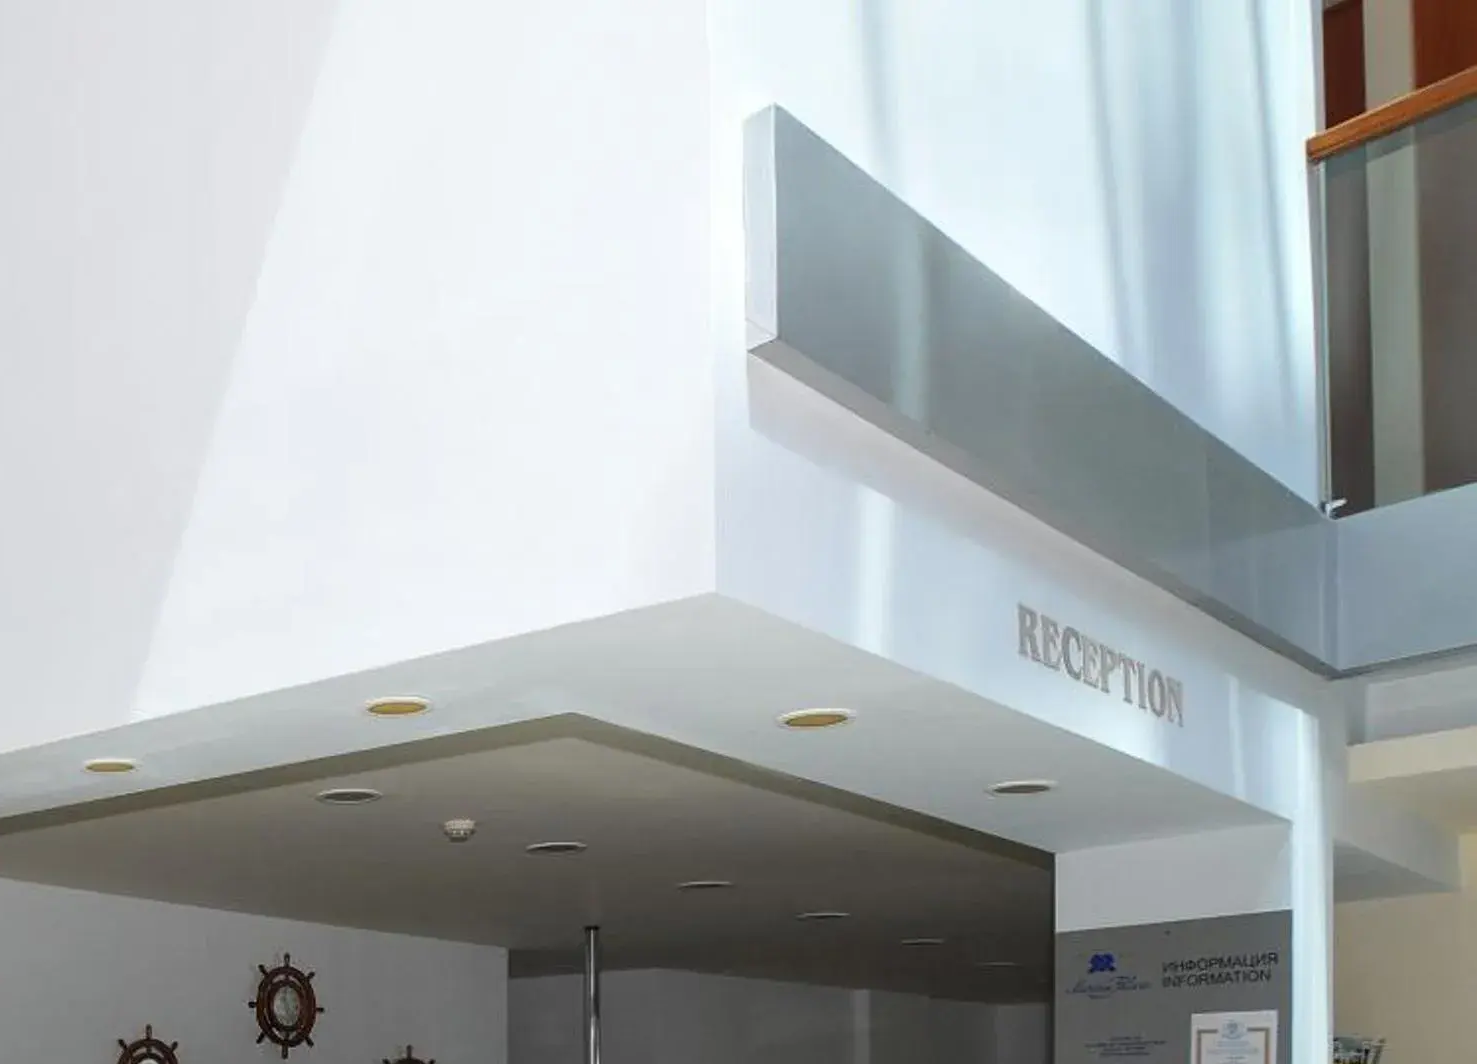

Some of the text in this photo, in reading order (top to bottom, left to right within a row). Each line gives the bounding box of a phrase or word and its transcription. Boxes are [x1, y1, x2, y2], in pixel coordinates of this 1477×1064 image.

[1017, 602, 1184, 727] RECEPTION
[1162, 952, 1278, 974] ИНФОРМАЦИЯ
[1162, 968, 1272, 988] INFORMATION
